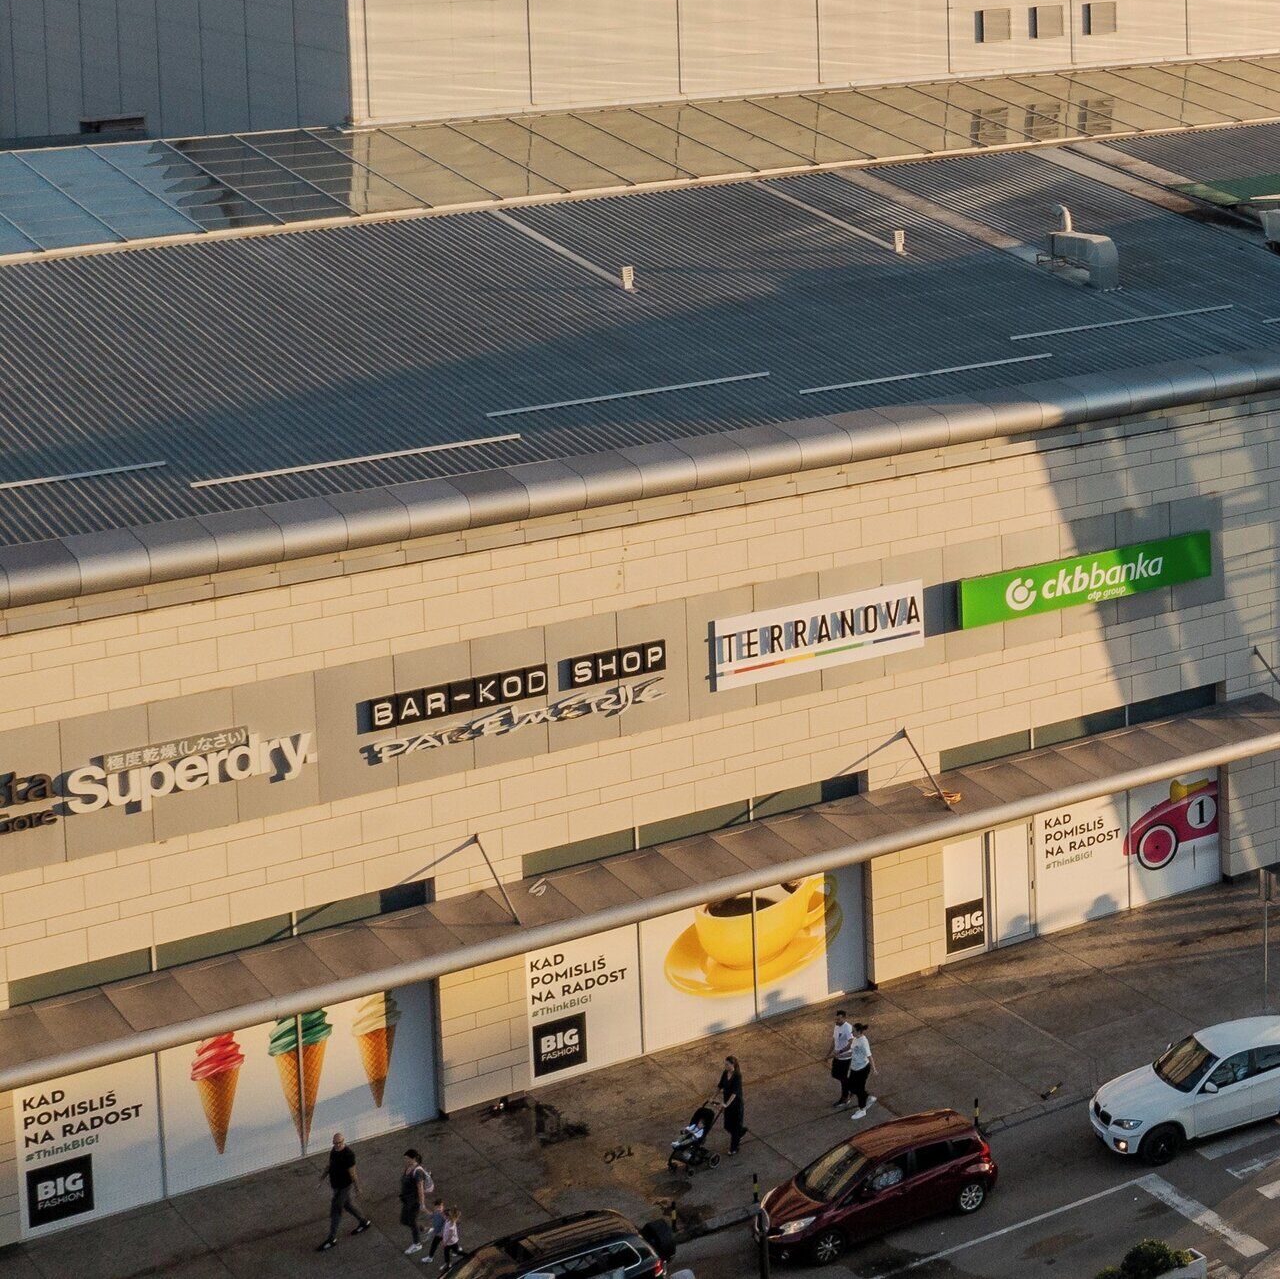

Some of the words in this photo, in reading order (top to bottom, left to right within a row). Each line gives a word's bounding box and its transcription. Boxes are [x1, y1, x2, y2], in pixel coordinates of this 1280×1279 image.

[722, 596, 921, 663] TERRANOVA
[373, 672, 547, 726] BAR-KOD
[573, 646, 663, 683] SHOP
[106, 727, 248, 771] 極度乾燥(しなさい)
[1044, 814, 1072, 830] KAD
[1045, 816, 1105, 844] POMISLIŠ
[1045, 845, 1065, 859] NA
[1069, 828, 1121, 853] RADOST
[1045, 850, 1093, 870] #ThinkBIG!
[951, 911, 984, 933] BIG
[952, 925, 984, 941] FASHION
[530, 954, 565, 972] KAD
[531, 954, 607, 989] POMISLIŠ
[531, 989, 556, 1005] NA
[561, 968, 627, 997] RADOST
[531, 994, 592, 1018] #ThinkBIG!
[541, 1028, 579, 1054] BIG
[541, 1044, 580, 1062] FASHION
[22, 1090, 65, 1111] KAD
[24, 1090, 117, 1130] POMISLIŠ
[25, 1130, 55, 1148] NA
[62, 1104, 143, 1138] RADOST
[25, 1134, 100, 1162] #ThinkBIG!
[37, 1172, 84, 1201] BIG
[38, 1190, 84, 1210] FASHION
